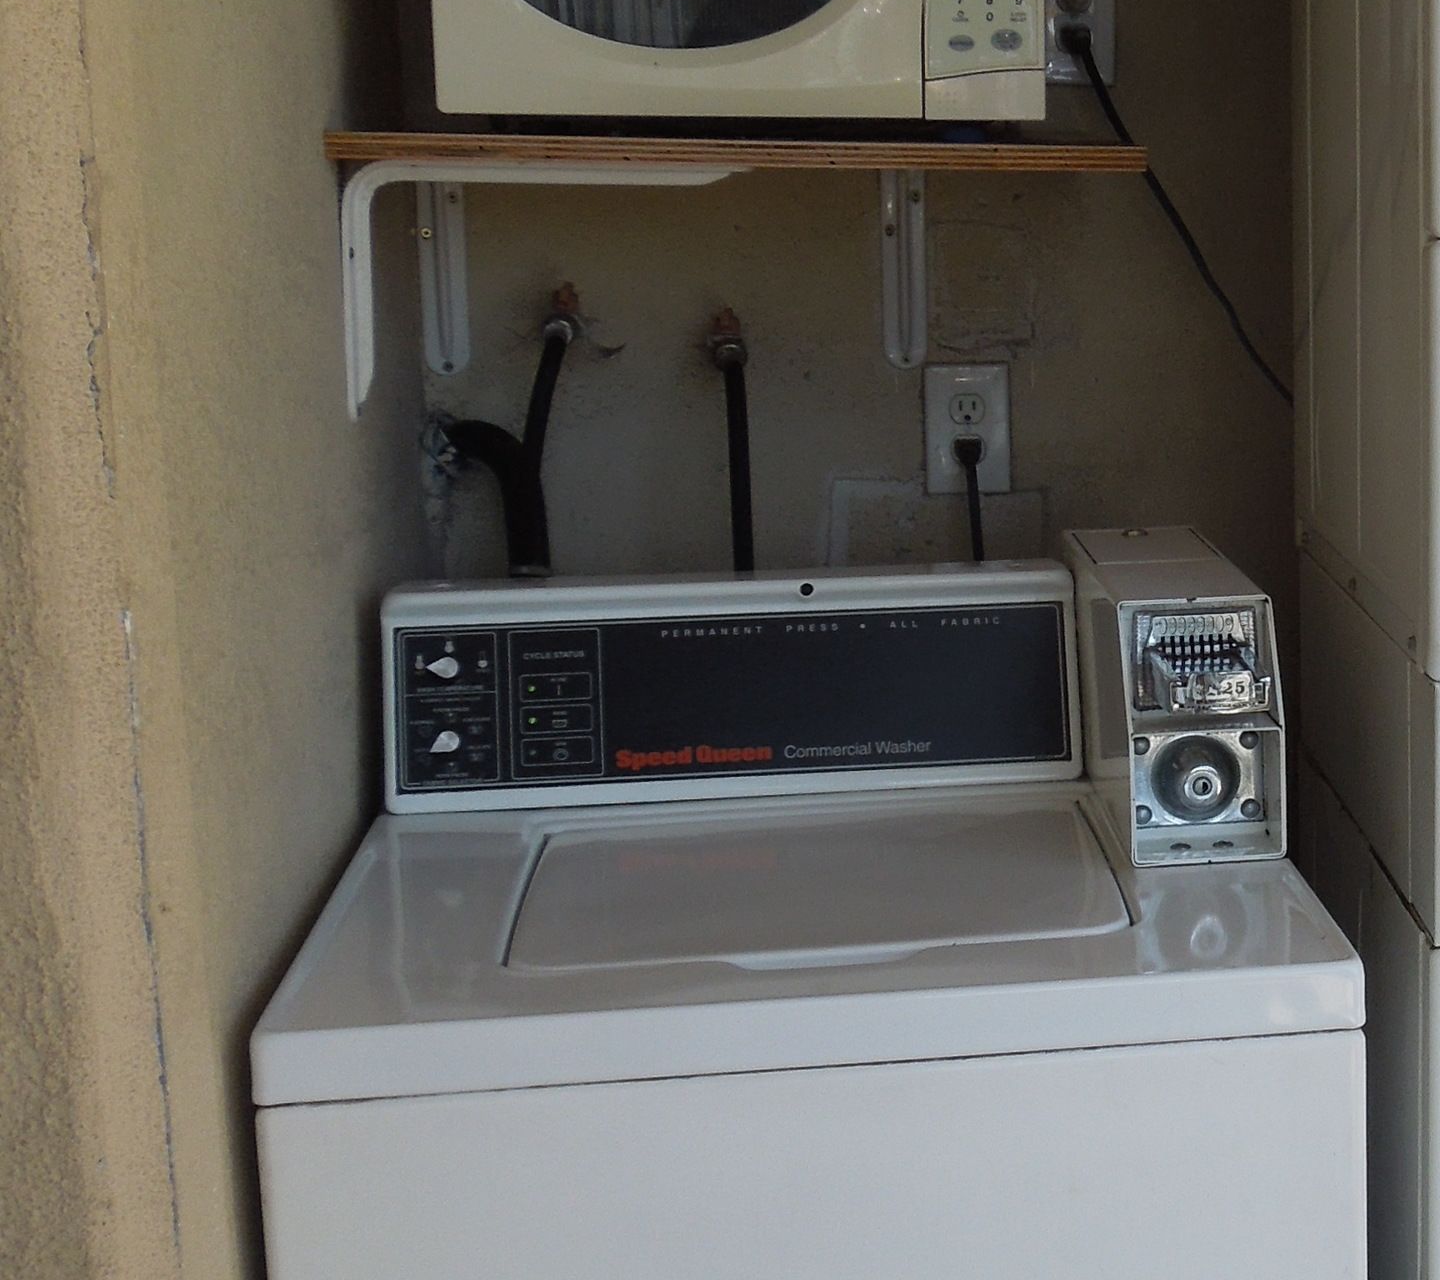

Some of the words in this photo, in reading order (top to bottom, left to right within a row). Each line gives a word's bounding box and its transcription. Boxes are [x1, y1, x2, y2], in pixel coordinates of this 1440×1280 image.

[985, 11, 994, 22] 0
[661, 626, 763, 638] PERMANENT
[785, 622, 839, 632] PRESS
[889, 620, 918, 629] ALL
[940, 616, 1000, 626] FABRIC
[615, 746, 691, 771] Speed
[695, 745, 773, 764] Queen
[783, 741, 872, 759] Commercial
[875, 740, 932, 756] Washer
